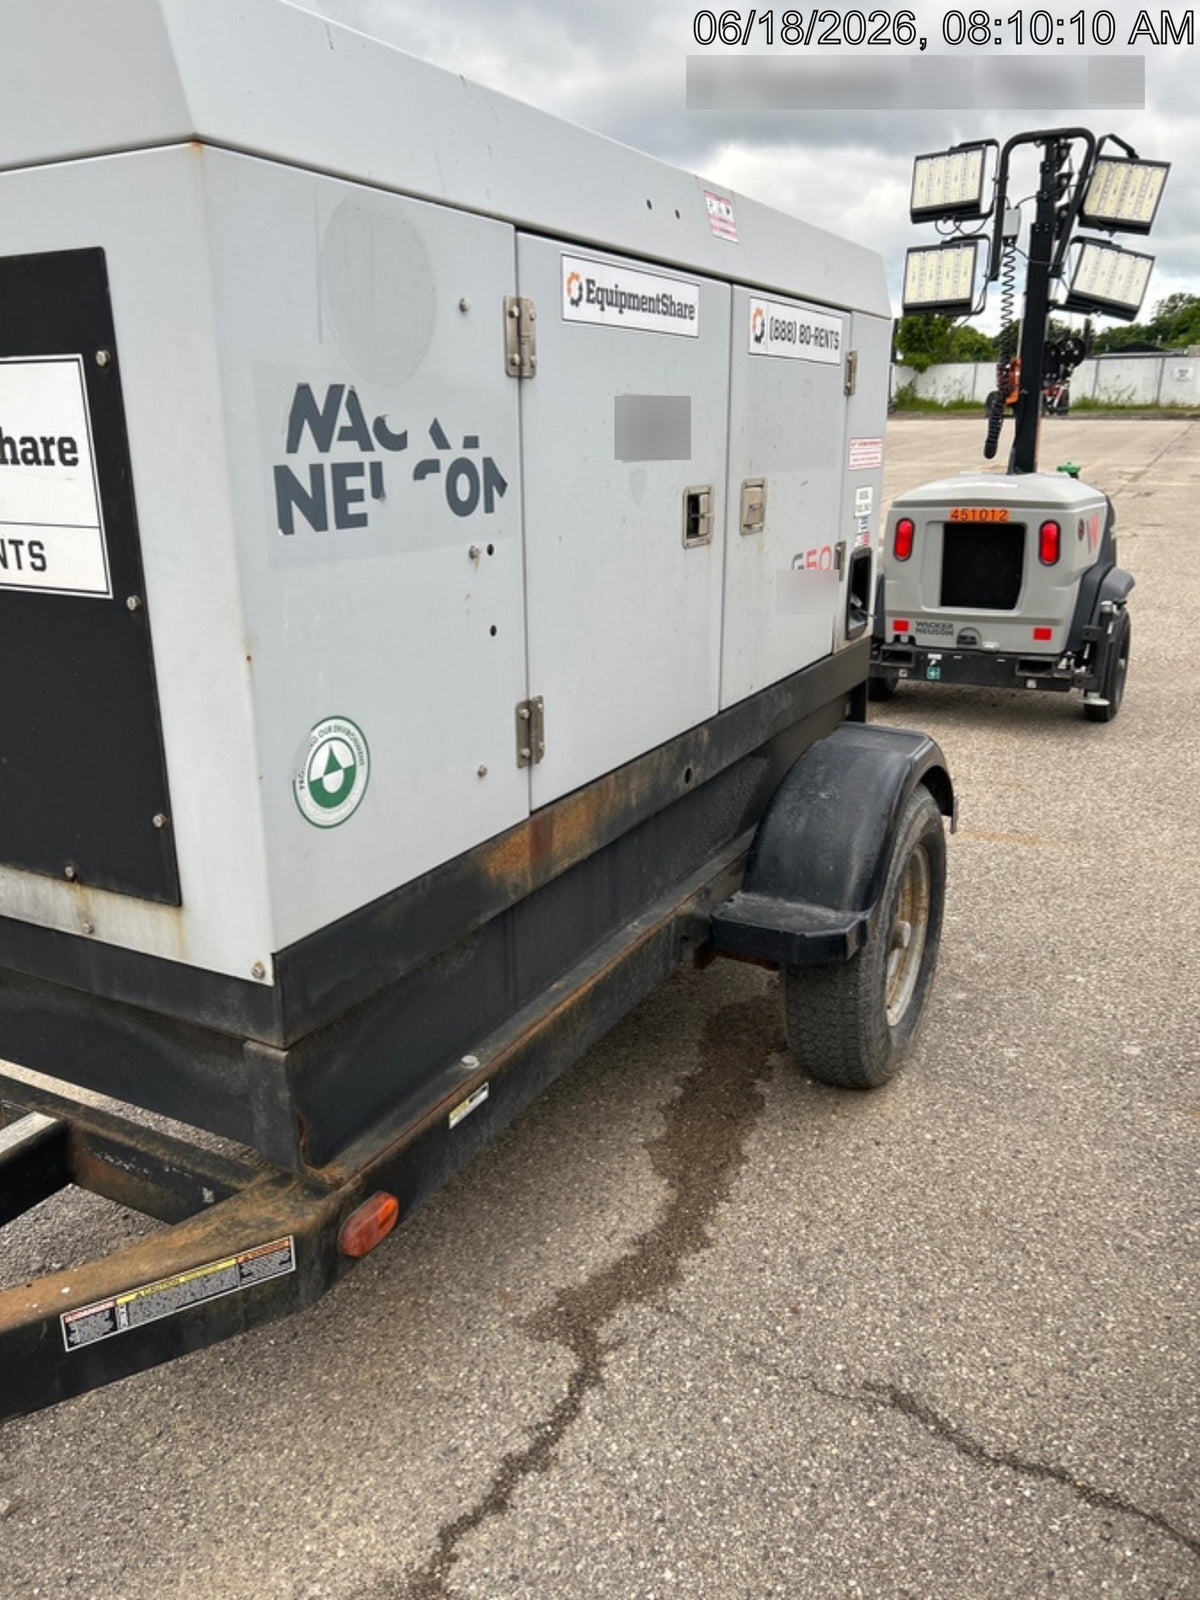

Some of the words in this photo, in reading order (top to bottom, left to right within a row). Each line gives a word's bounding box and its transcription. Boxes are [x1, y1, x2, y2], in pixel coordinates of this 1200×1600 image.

[585, 278, 697, 321] EquipmentShare
[769, 316, 797, 345] (888)
[799, 324, 840, 351] 80-RENTS
[950, 508, 1008, 521] 451012
